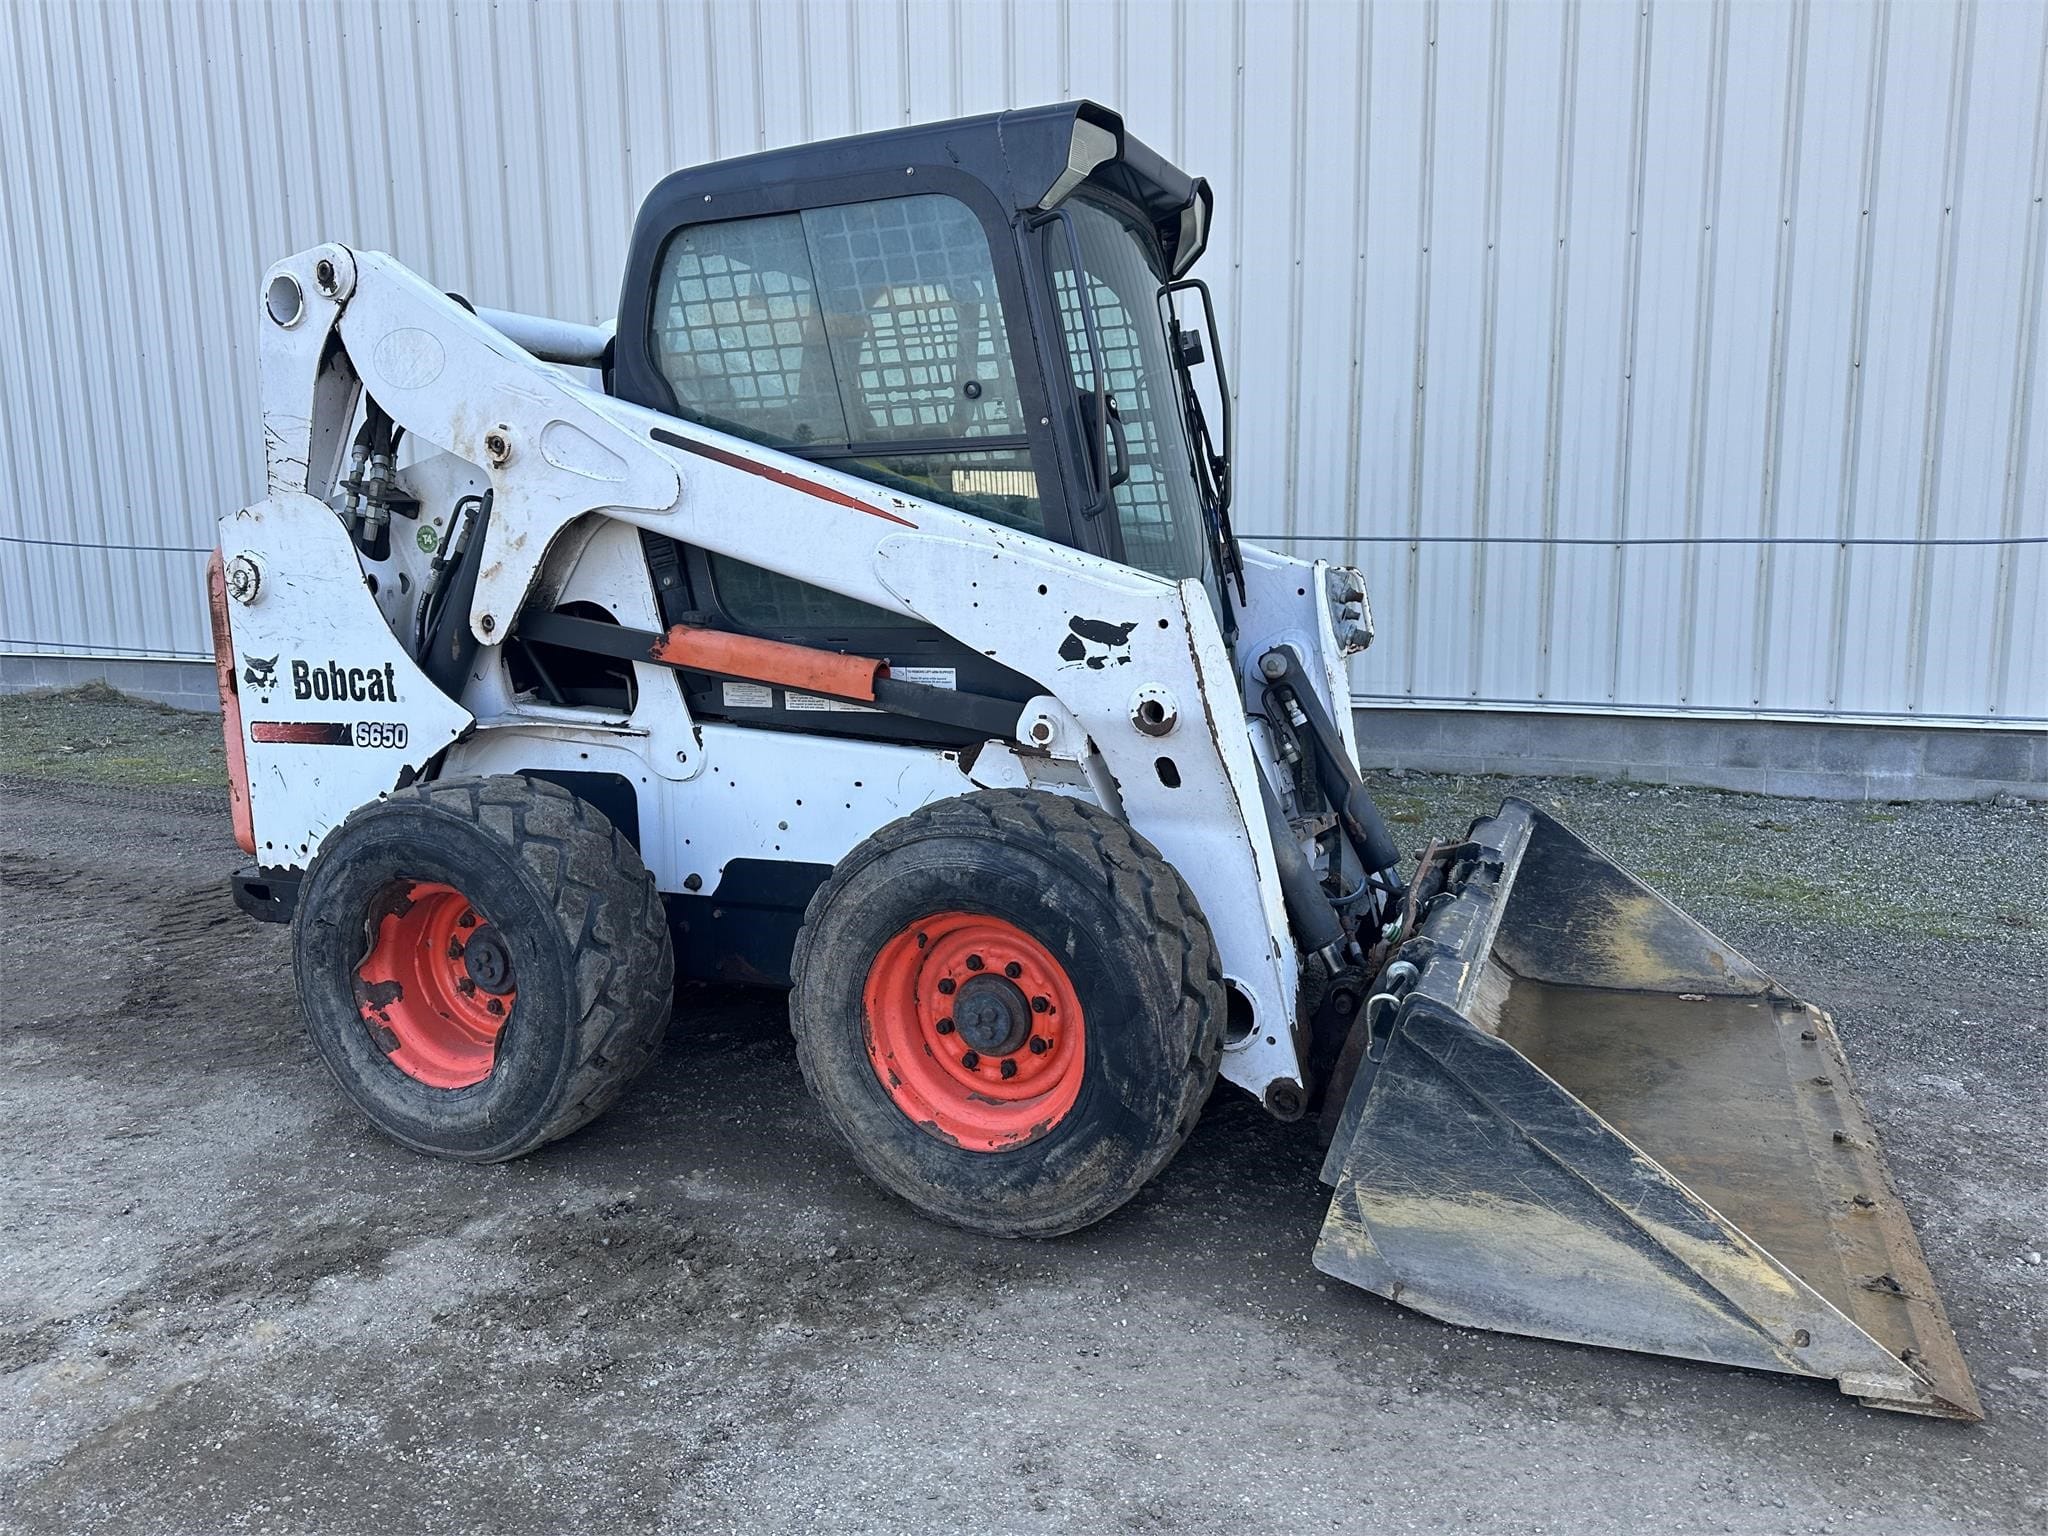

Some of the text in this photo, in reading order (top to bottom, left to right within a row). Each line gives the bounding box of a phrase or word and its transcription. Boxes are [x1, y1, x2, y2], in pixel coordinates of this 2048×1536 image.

[422, 534, 433, 545] T4
[291, 659, 397, 702] Bobcat
[356, 722, 408, 749] S650
